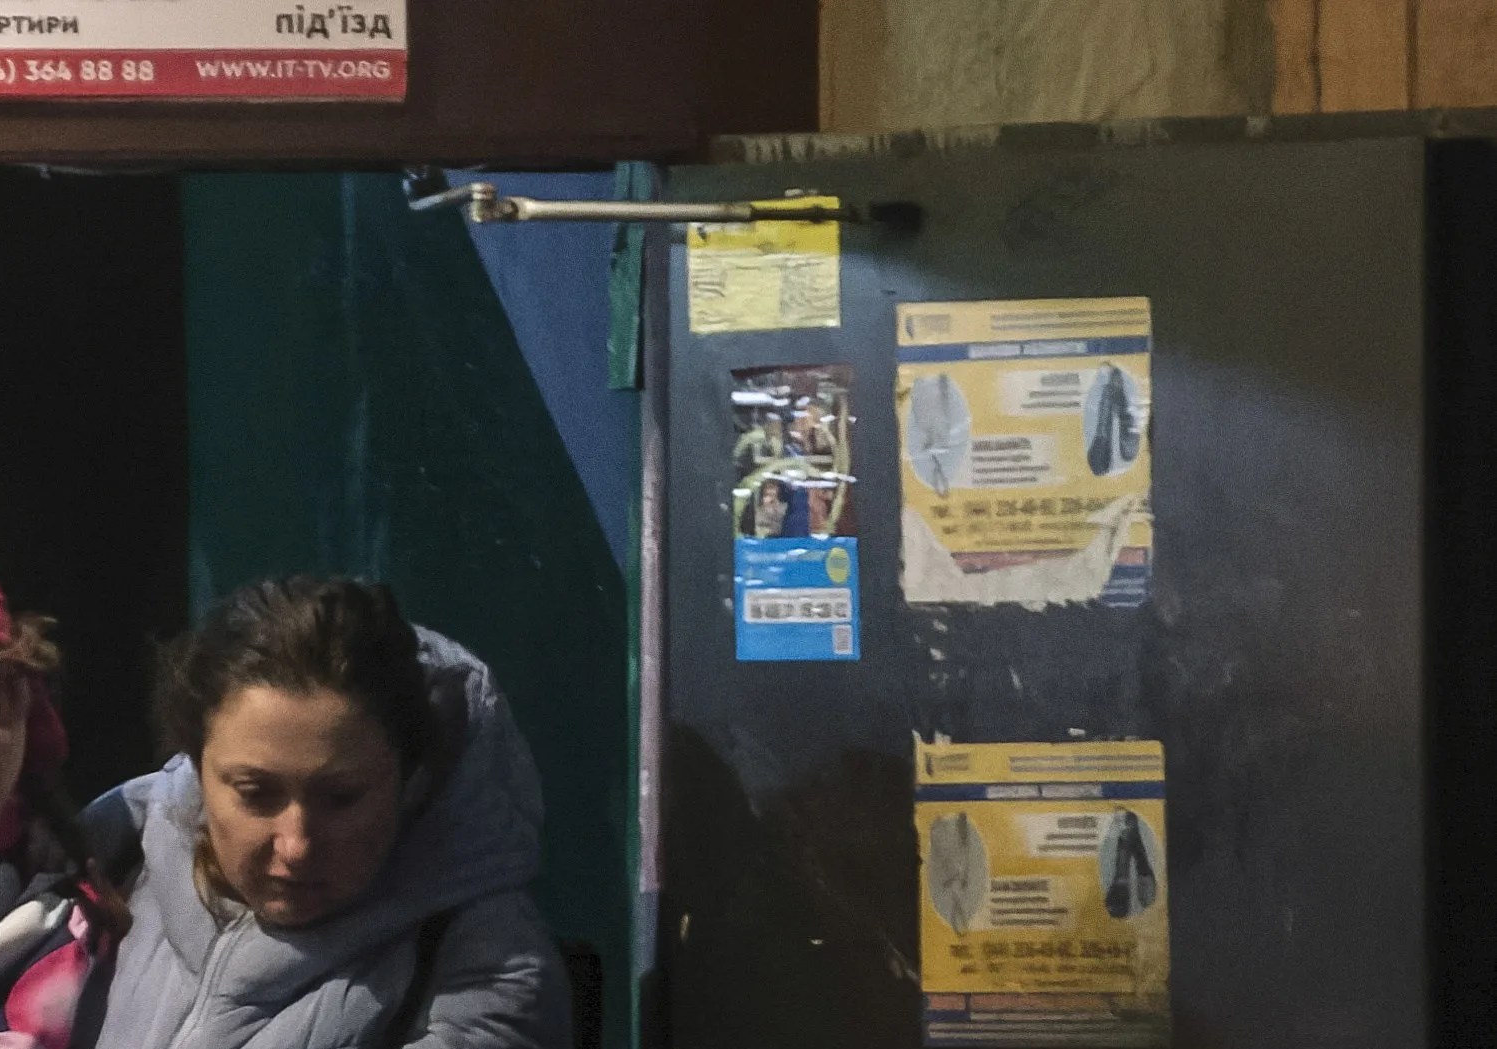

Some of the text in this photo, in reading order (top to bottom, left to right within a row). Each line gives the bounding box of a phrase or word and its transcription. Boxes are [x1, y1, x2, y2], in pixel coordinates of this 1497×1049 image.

[24, 59, 73, 81] 364
[80, 59, 113, 81] 88
[121, 59, 155, 81] 88
[195, 59, 392, 80] WWW.IT-TV.ORG
